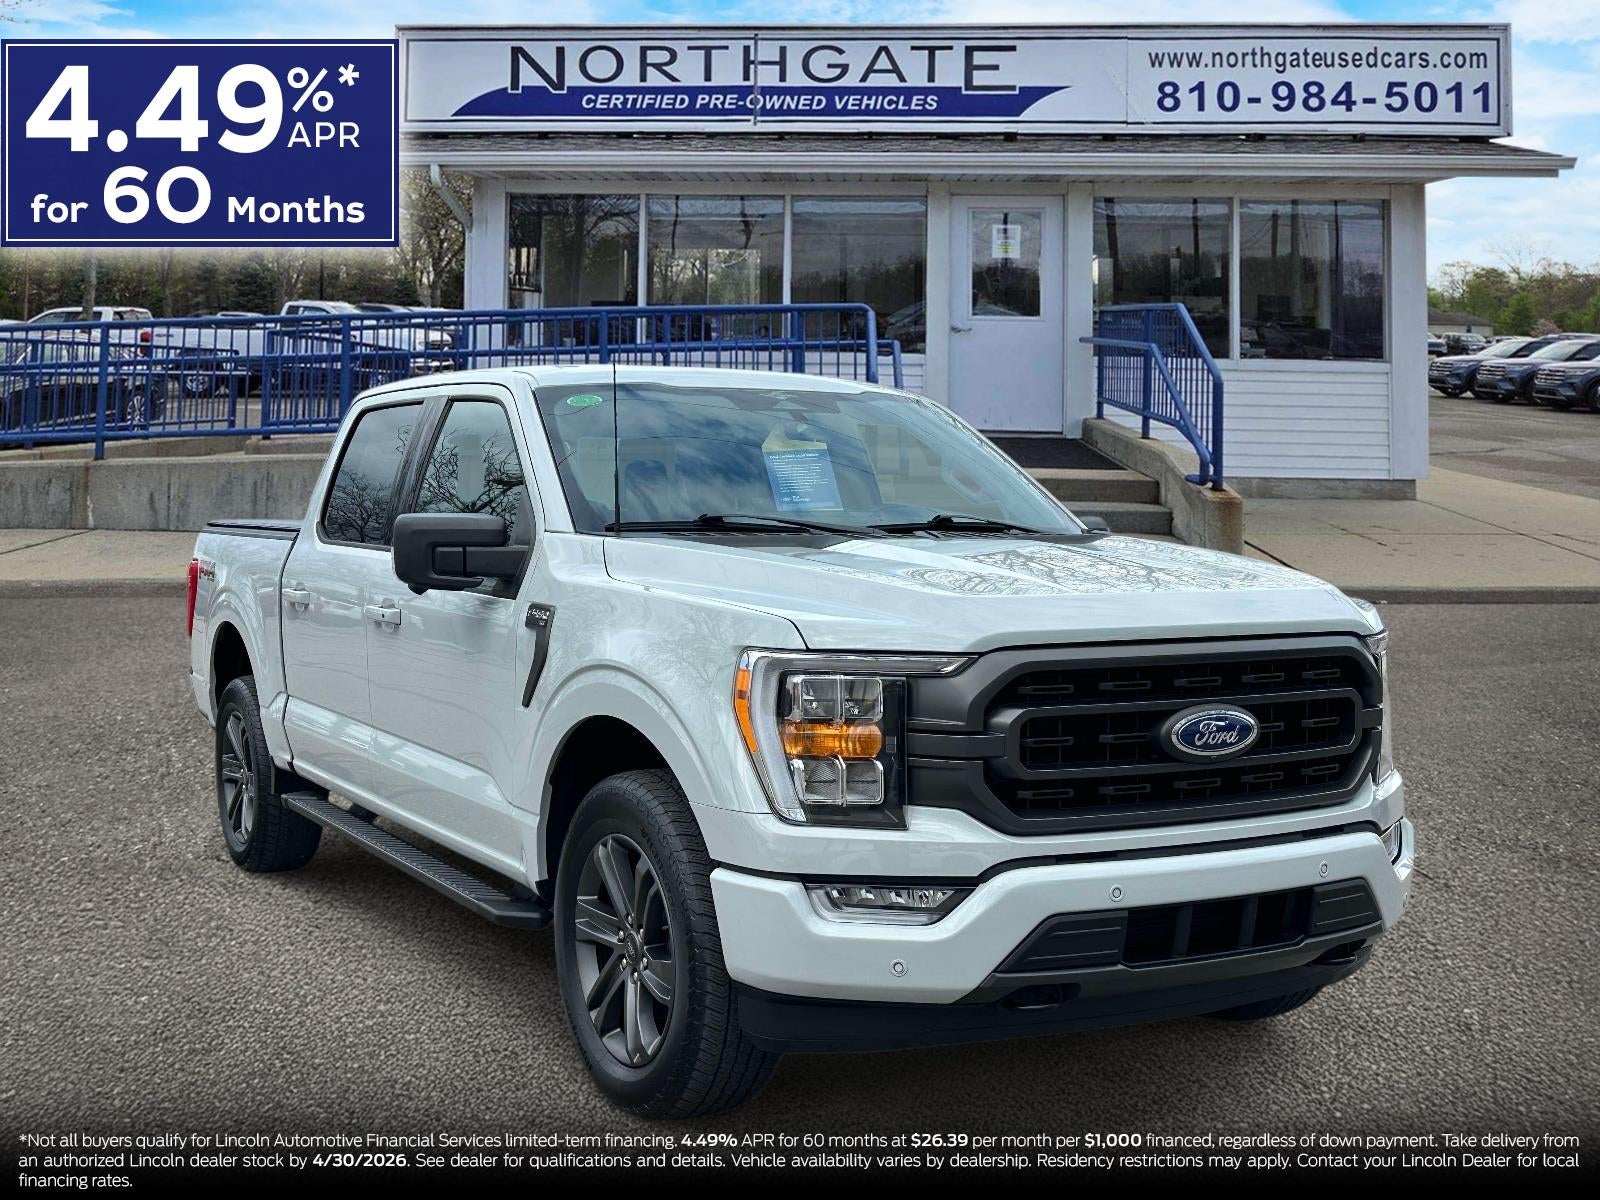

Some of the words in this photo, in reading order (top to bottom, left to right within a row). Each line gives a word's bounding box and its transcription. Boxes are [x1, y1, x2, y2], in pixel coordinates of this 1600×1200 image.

[509, 45, 1018, 92] NORTHGATE
[1148, 46, 1489, 74] www.northgateusedcars.com
[581, 94, 690, 110] CERTIFIED
[695, 94, 828, 110] PRE-OWNED
[834, 94, 939, 111] VEHICLES
[1156, 80, 1491, 114] 810-984-5011
[1194, 720, 1240, 746] Ford
